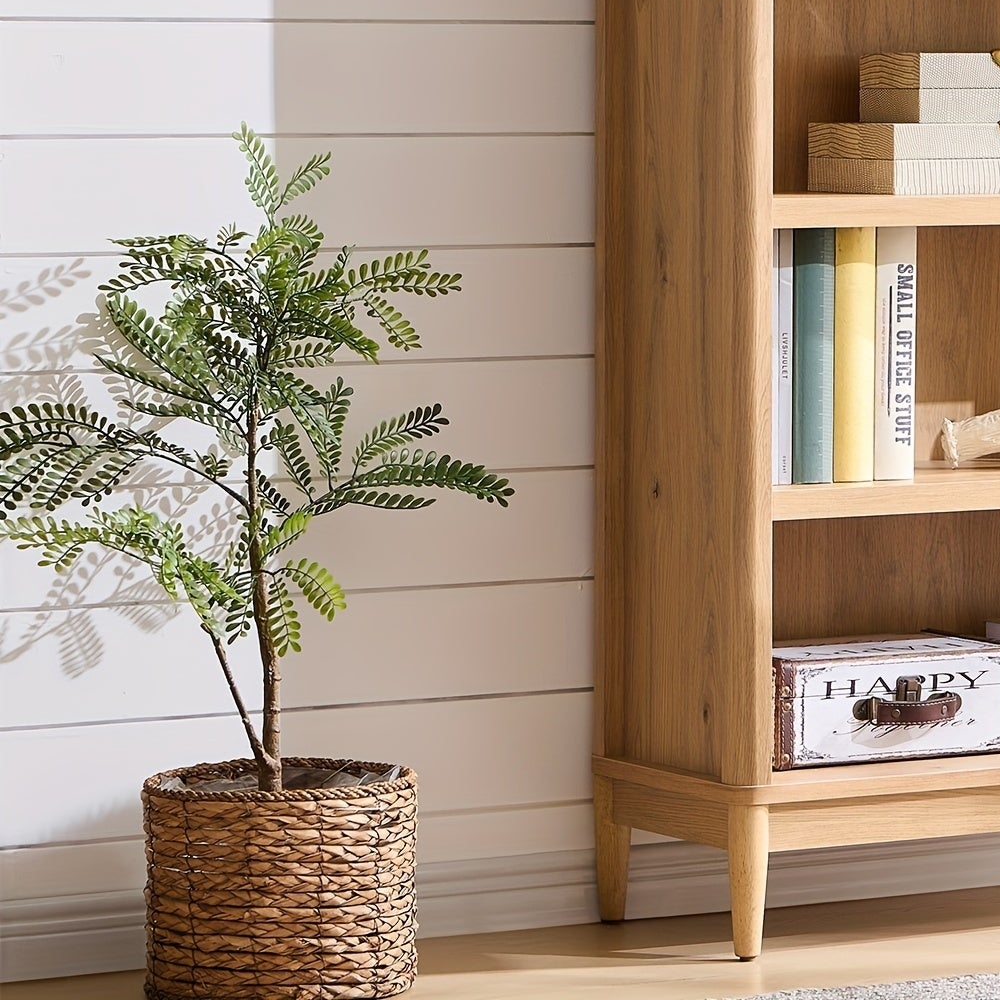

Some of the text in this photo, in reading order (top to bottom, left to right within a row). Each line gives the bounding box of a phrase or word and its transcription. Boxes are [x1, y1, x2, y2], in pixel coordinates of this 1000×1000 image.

[895, 264, 914, 446] SMALL OFFICE STUFF
[823, 670, 989, 700] HAPY
